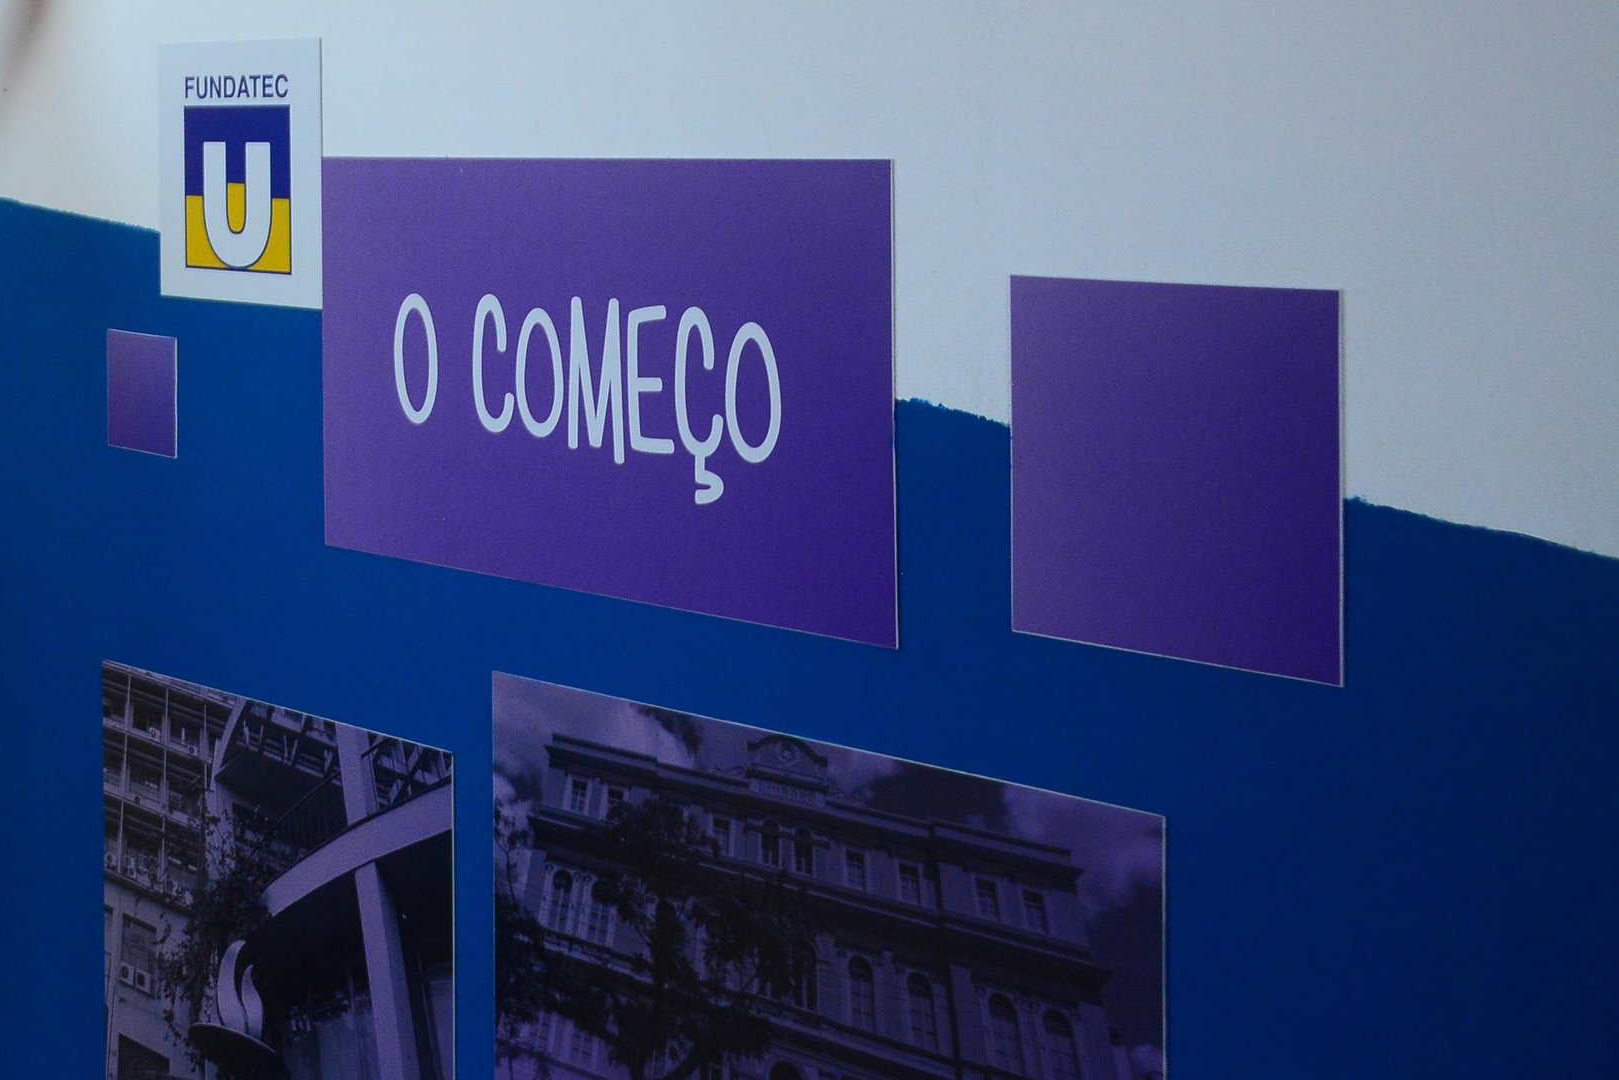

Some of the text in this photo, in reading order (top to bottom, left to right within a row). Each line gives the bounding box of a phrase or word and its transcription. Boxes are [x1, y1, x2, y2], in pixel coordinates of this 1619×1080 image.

[184, 74, 289, 100] FUNDATEC
[393, 292, 781, 505] O COMEÇO
